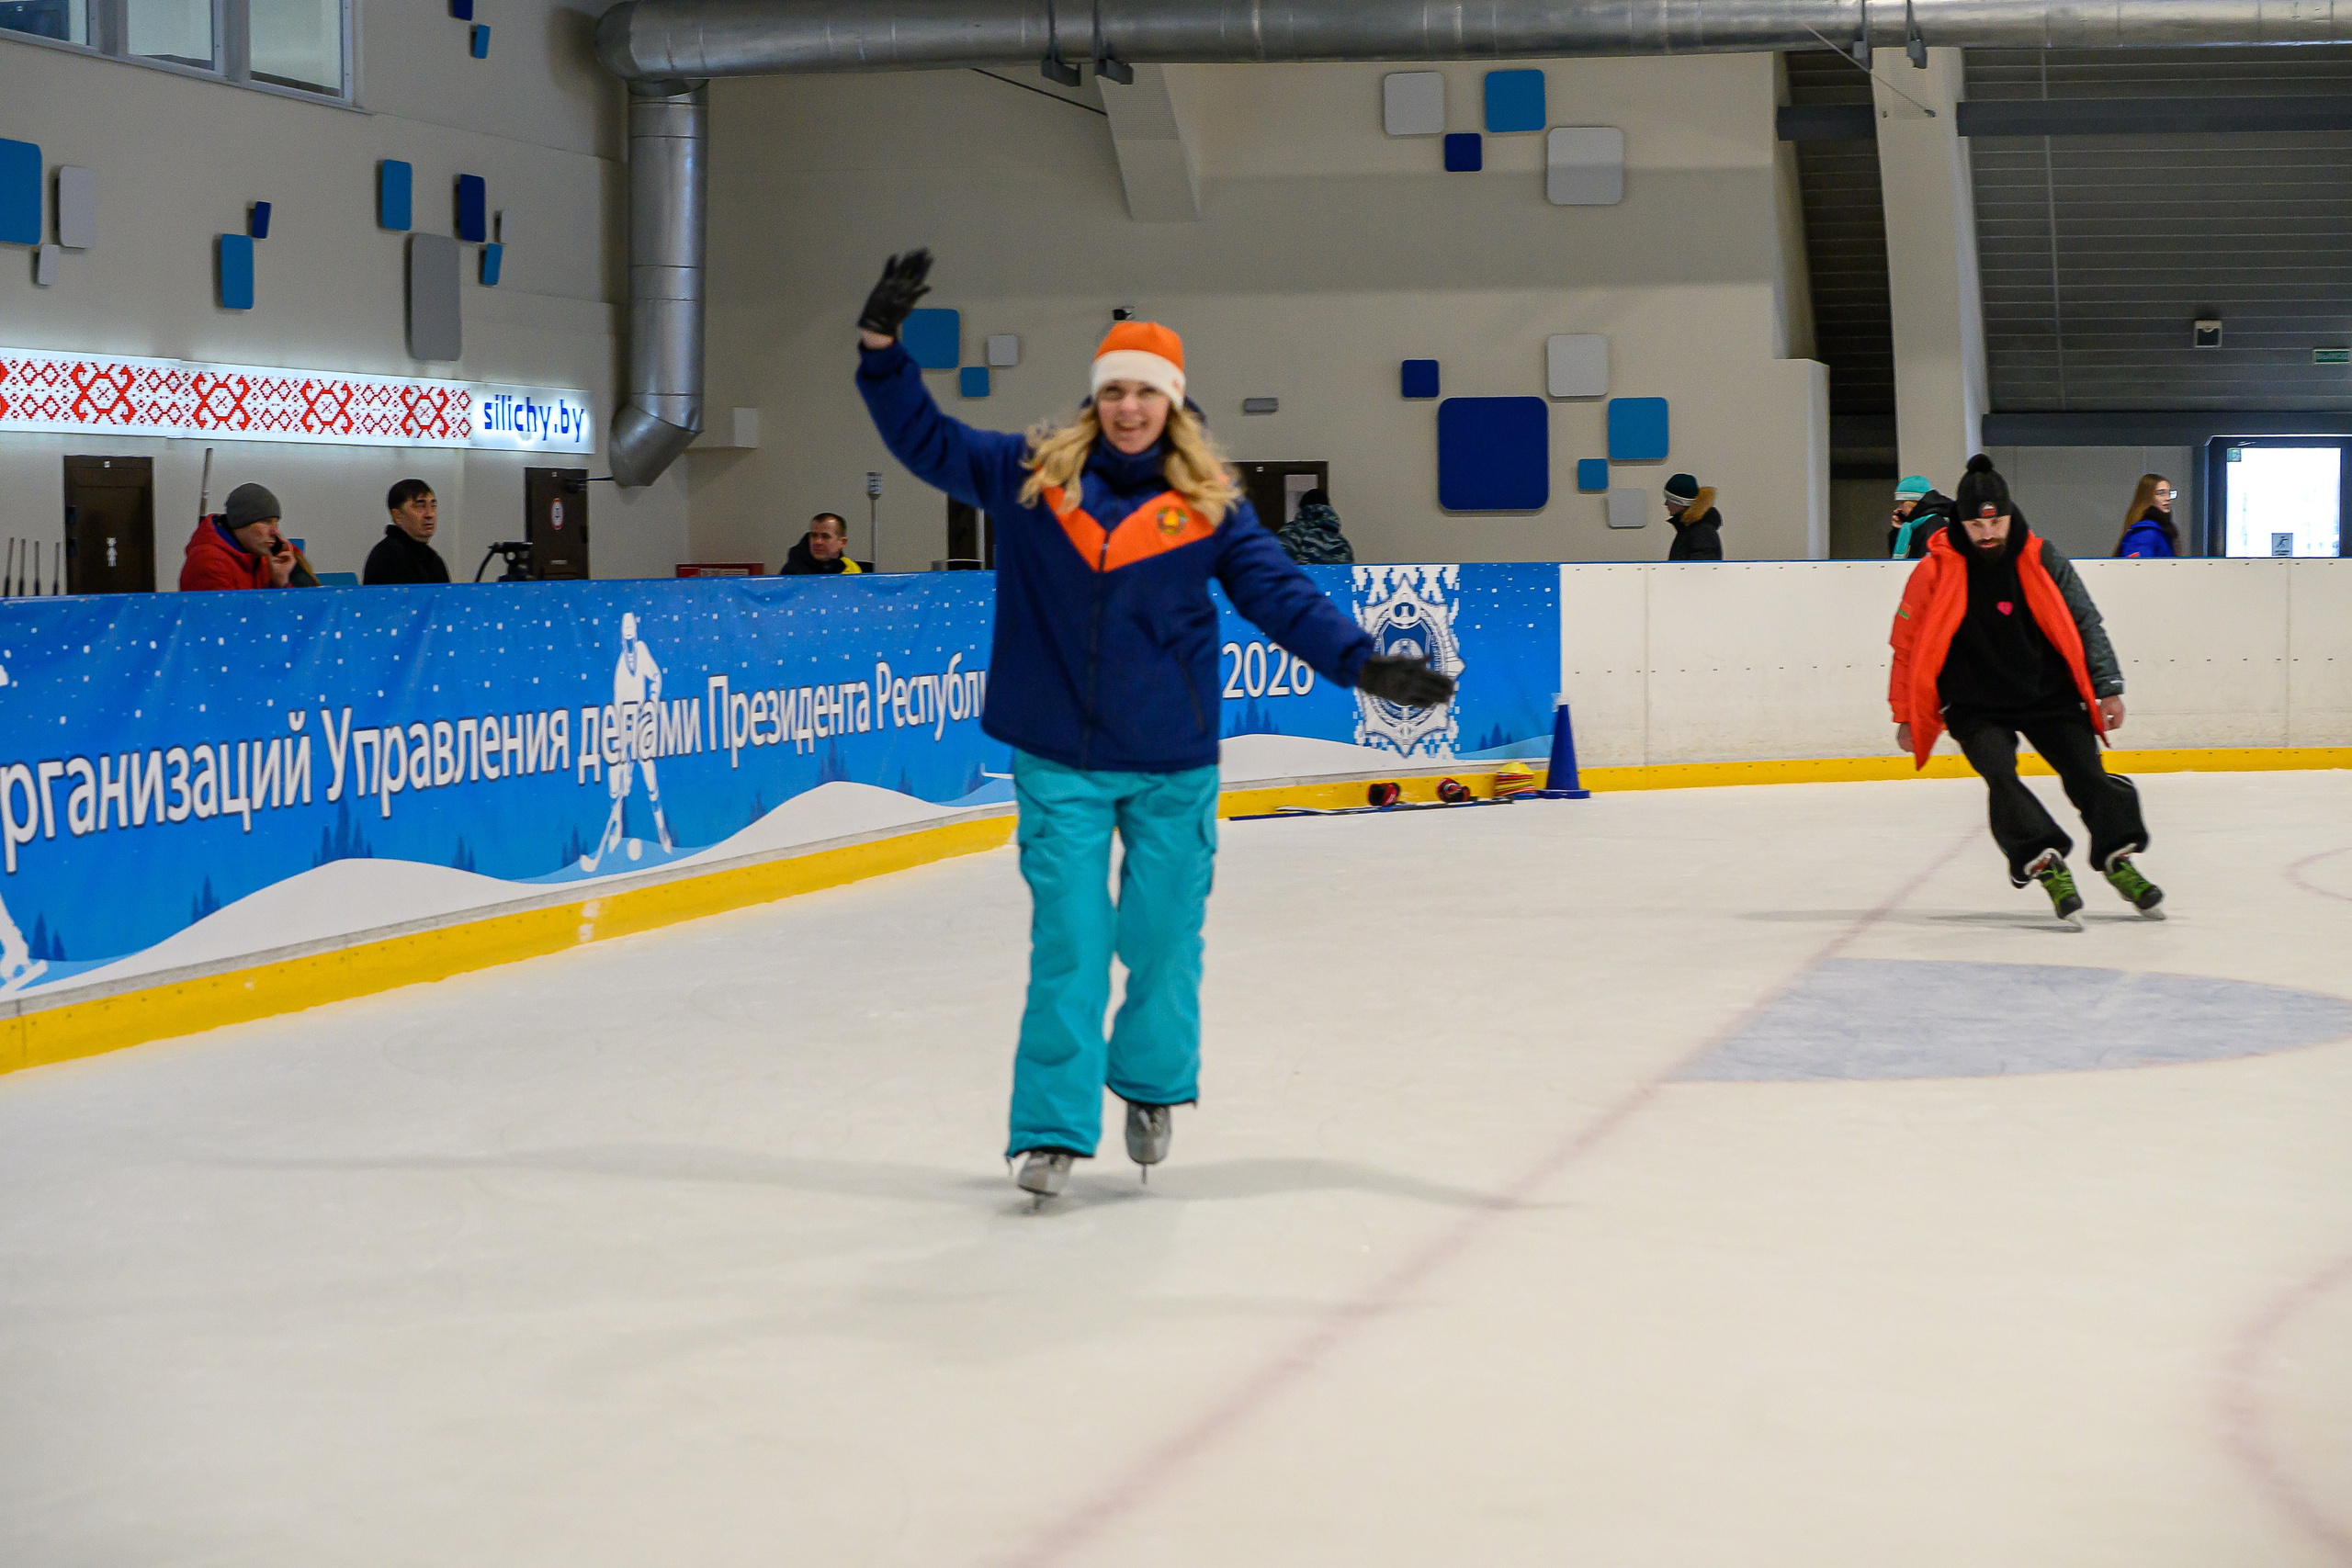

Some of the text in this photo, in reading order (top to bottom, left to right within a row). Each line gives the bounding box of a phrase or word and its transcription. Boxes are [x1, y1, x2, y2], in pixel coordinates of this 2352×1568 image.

[483, 394, 585, 443] silichy.by
[1222, 641, 1315, 698] 2026
[321, 705, 570, 818] Управления
[577, 696, 703, 784] делами
[707, 673, 872, 768] Президента
